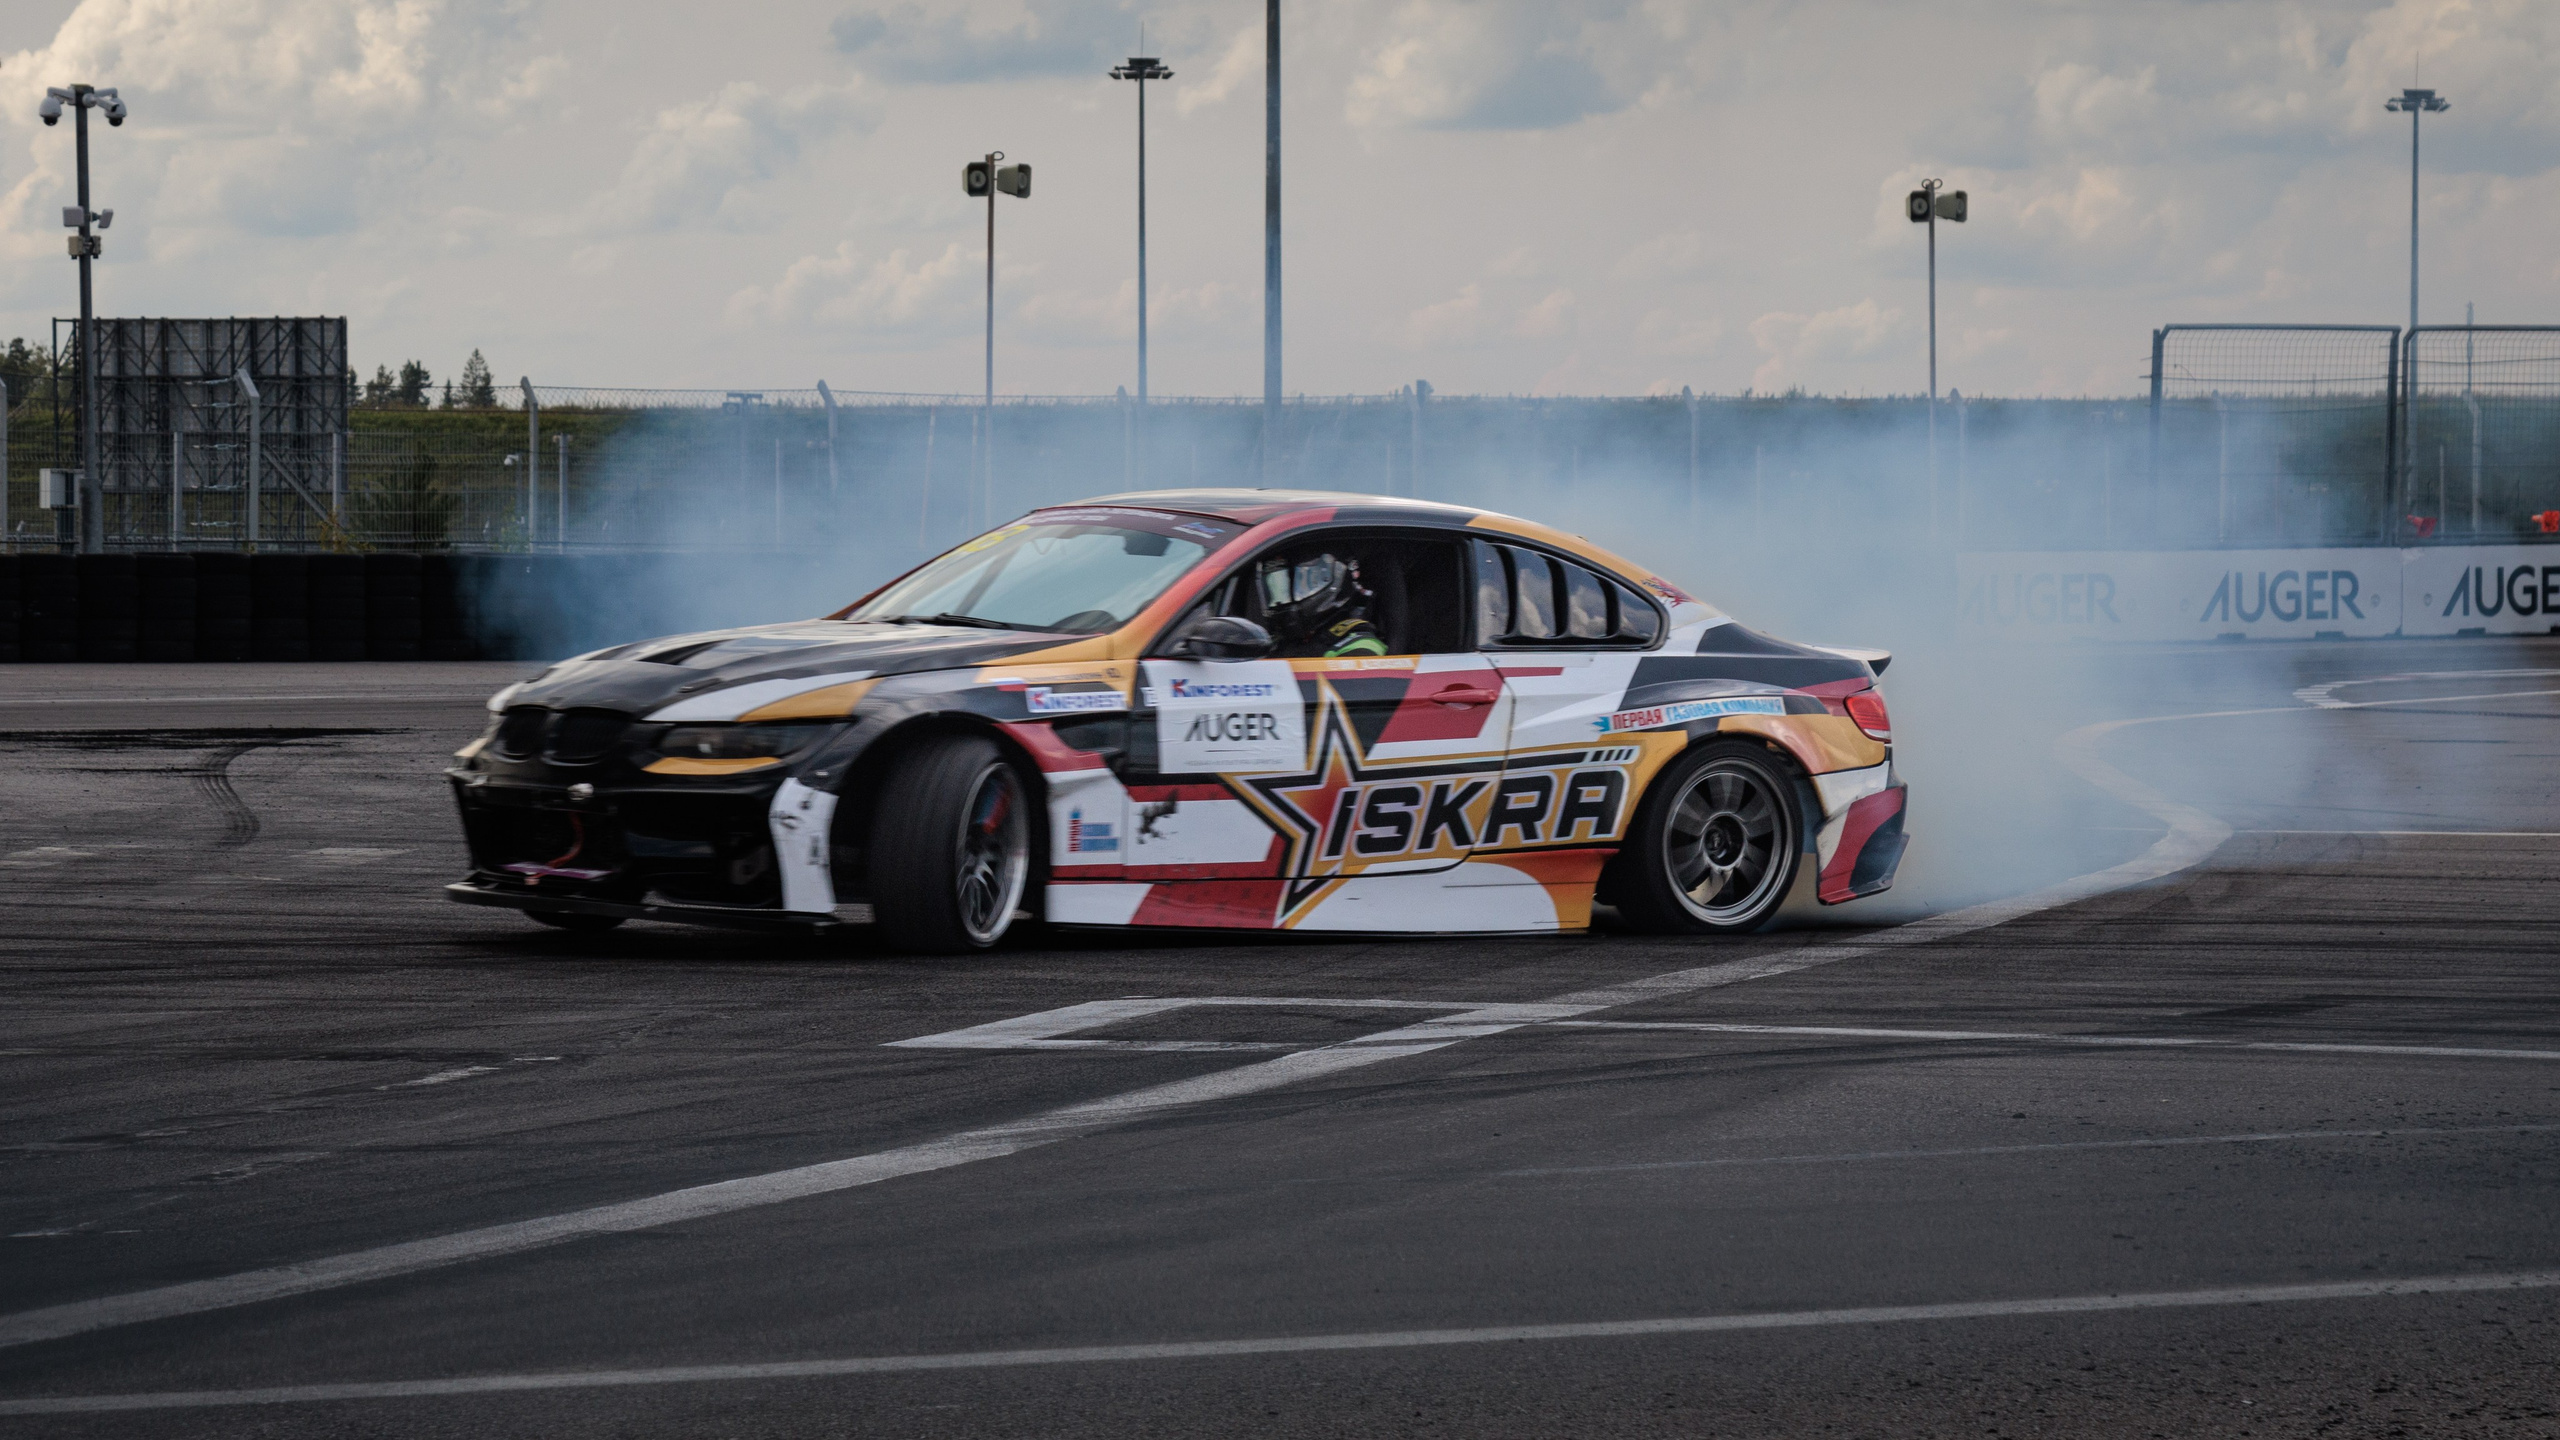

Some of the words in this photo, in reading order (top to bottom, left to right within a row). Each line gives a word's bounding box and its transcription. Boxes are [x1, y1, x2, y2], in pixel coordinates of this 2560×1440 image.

[1960, 572, 2121, 624] AUGER
[2200, 569, 2366, 622] AUGER
[1184, 712, 1282, 742] AUGER
[1613, 708, 1664, 730] ПЕРВАЯ
[1666, 701, 1721, 722] ГАЗОВАЯ
[1320, 766, 1630, 861] ISKRA
